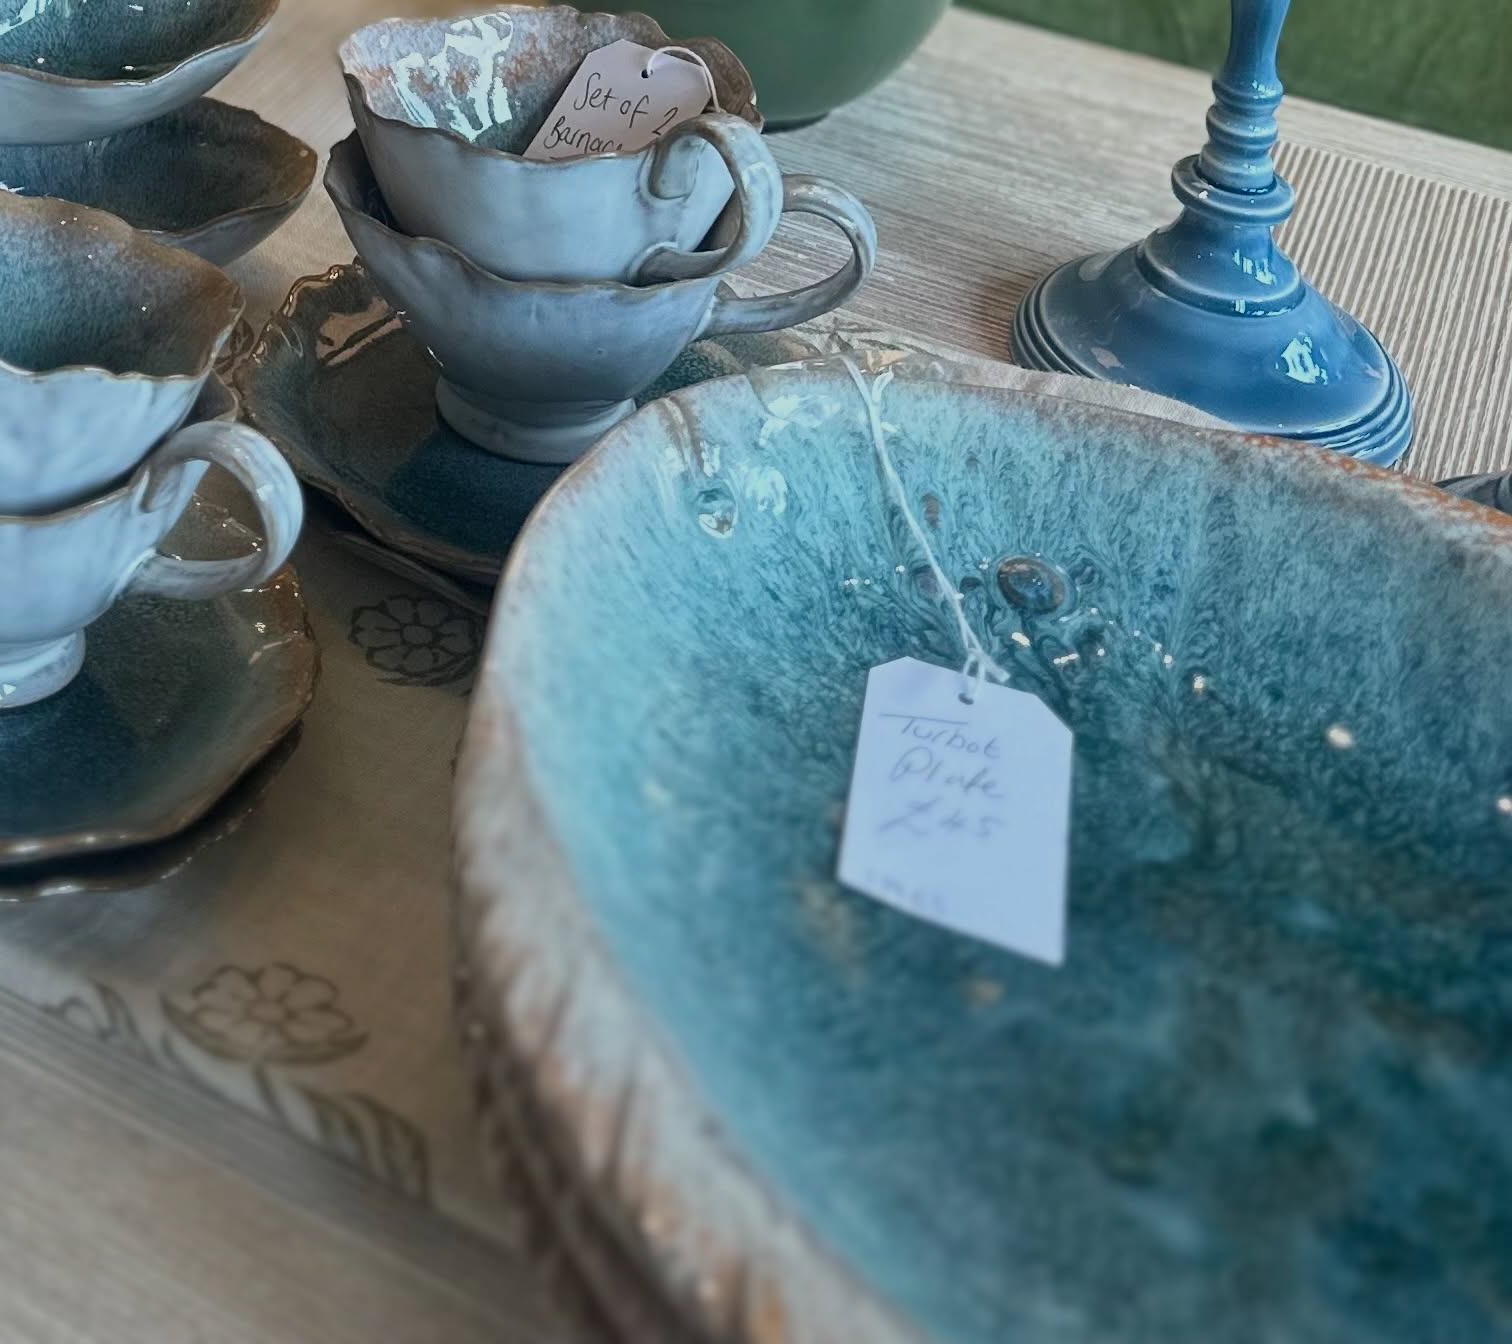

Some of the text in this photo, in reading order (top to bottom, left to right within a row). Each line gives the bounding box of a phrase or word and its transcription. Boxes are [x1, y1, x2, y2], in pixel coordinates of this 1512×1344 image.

[573, 72, 678, 135] Set of 2
[878, 712, 1002, 759] Turbot
[888, 746, 1005, 800] Plate
